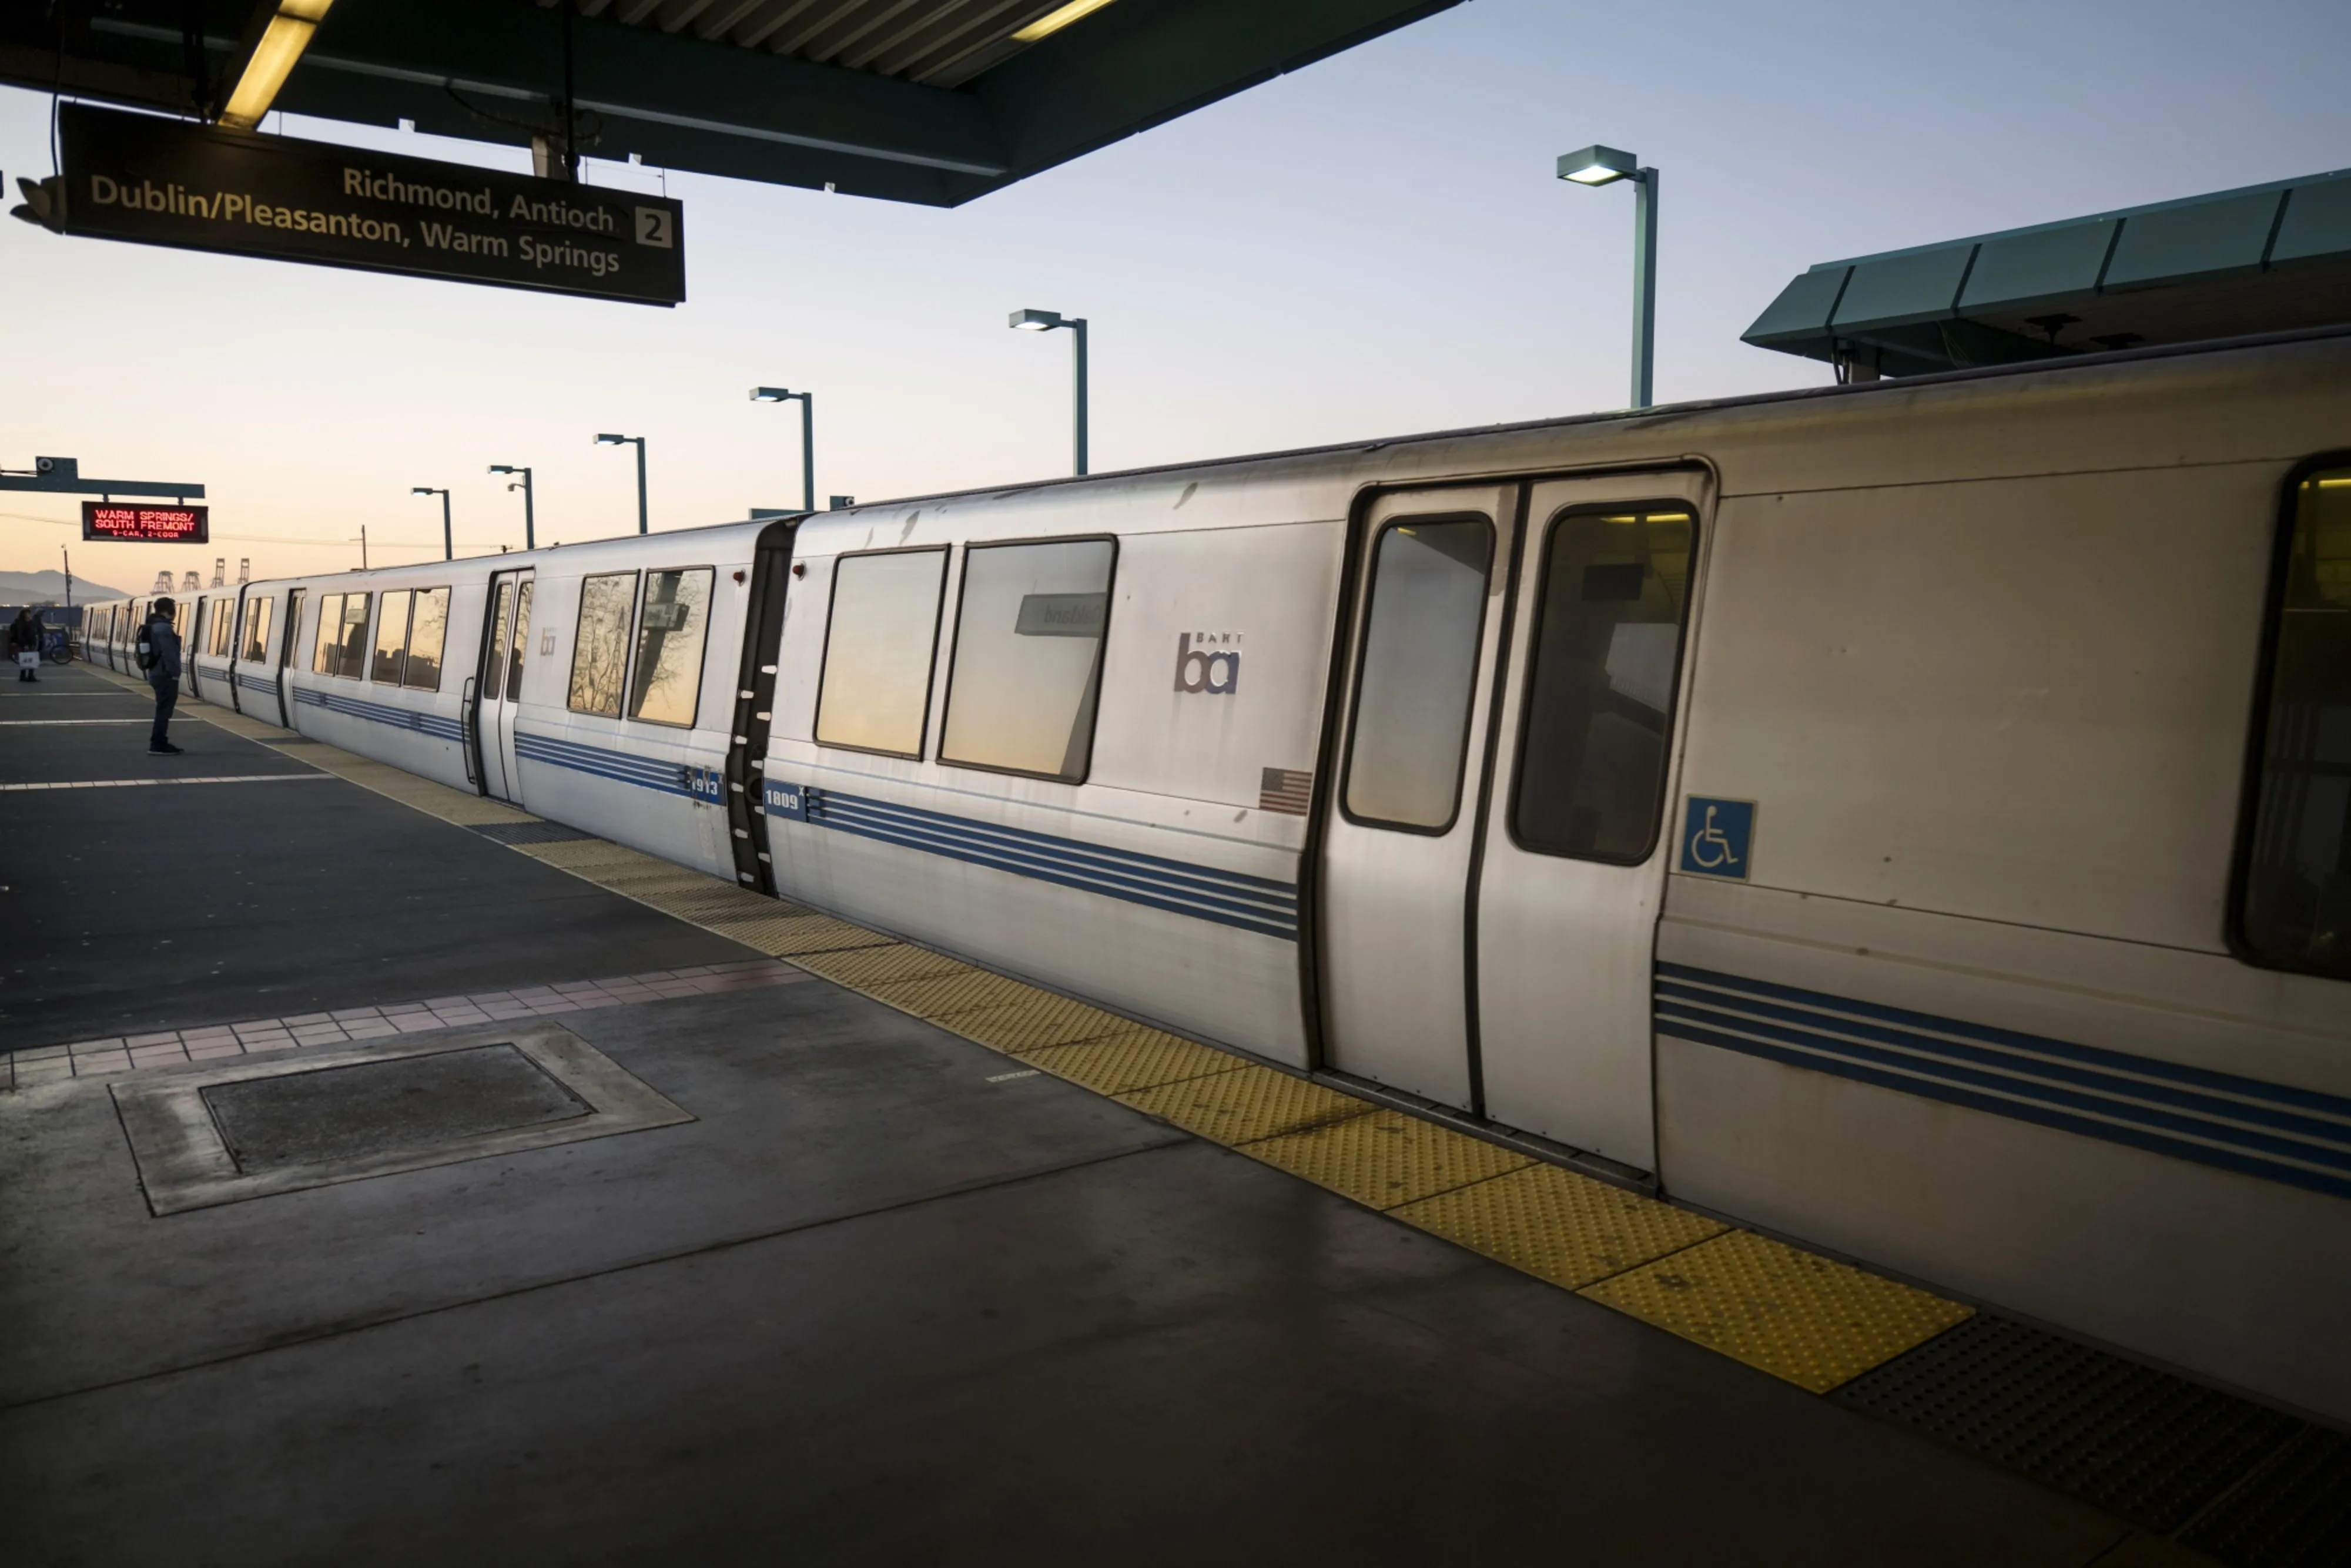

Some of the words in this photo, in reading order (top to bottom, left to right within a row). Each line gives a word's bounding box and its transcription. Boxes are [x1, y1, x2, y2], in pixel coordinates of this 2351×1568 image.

[343, 167, 499, 220] Richmond,
[509, 195, 613, 232] Antioch
[91, 175, 410, 247] Dublin/Pleasanton,
[420, 221, 508, 257] Warm
[519, 236, 619, 276] Springs
[644, 213, 664, 242] 2
[95, 510, 134, 520] WARM
[139, 512, 193, 521] SPRINGS/
[95, 520, 135, 529] SOUTH
[140, 521, 195, 531] FREMONT
[1196, 631, 1244, 644] BART
[766, 789, 798, 810] 1809
